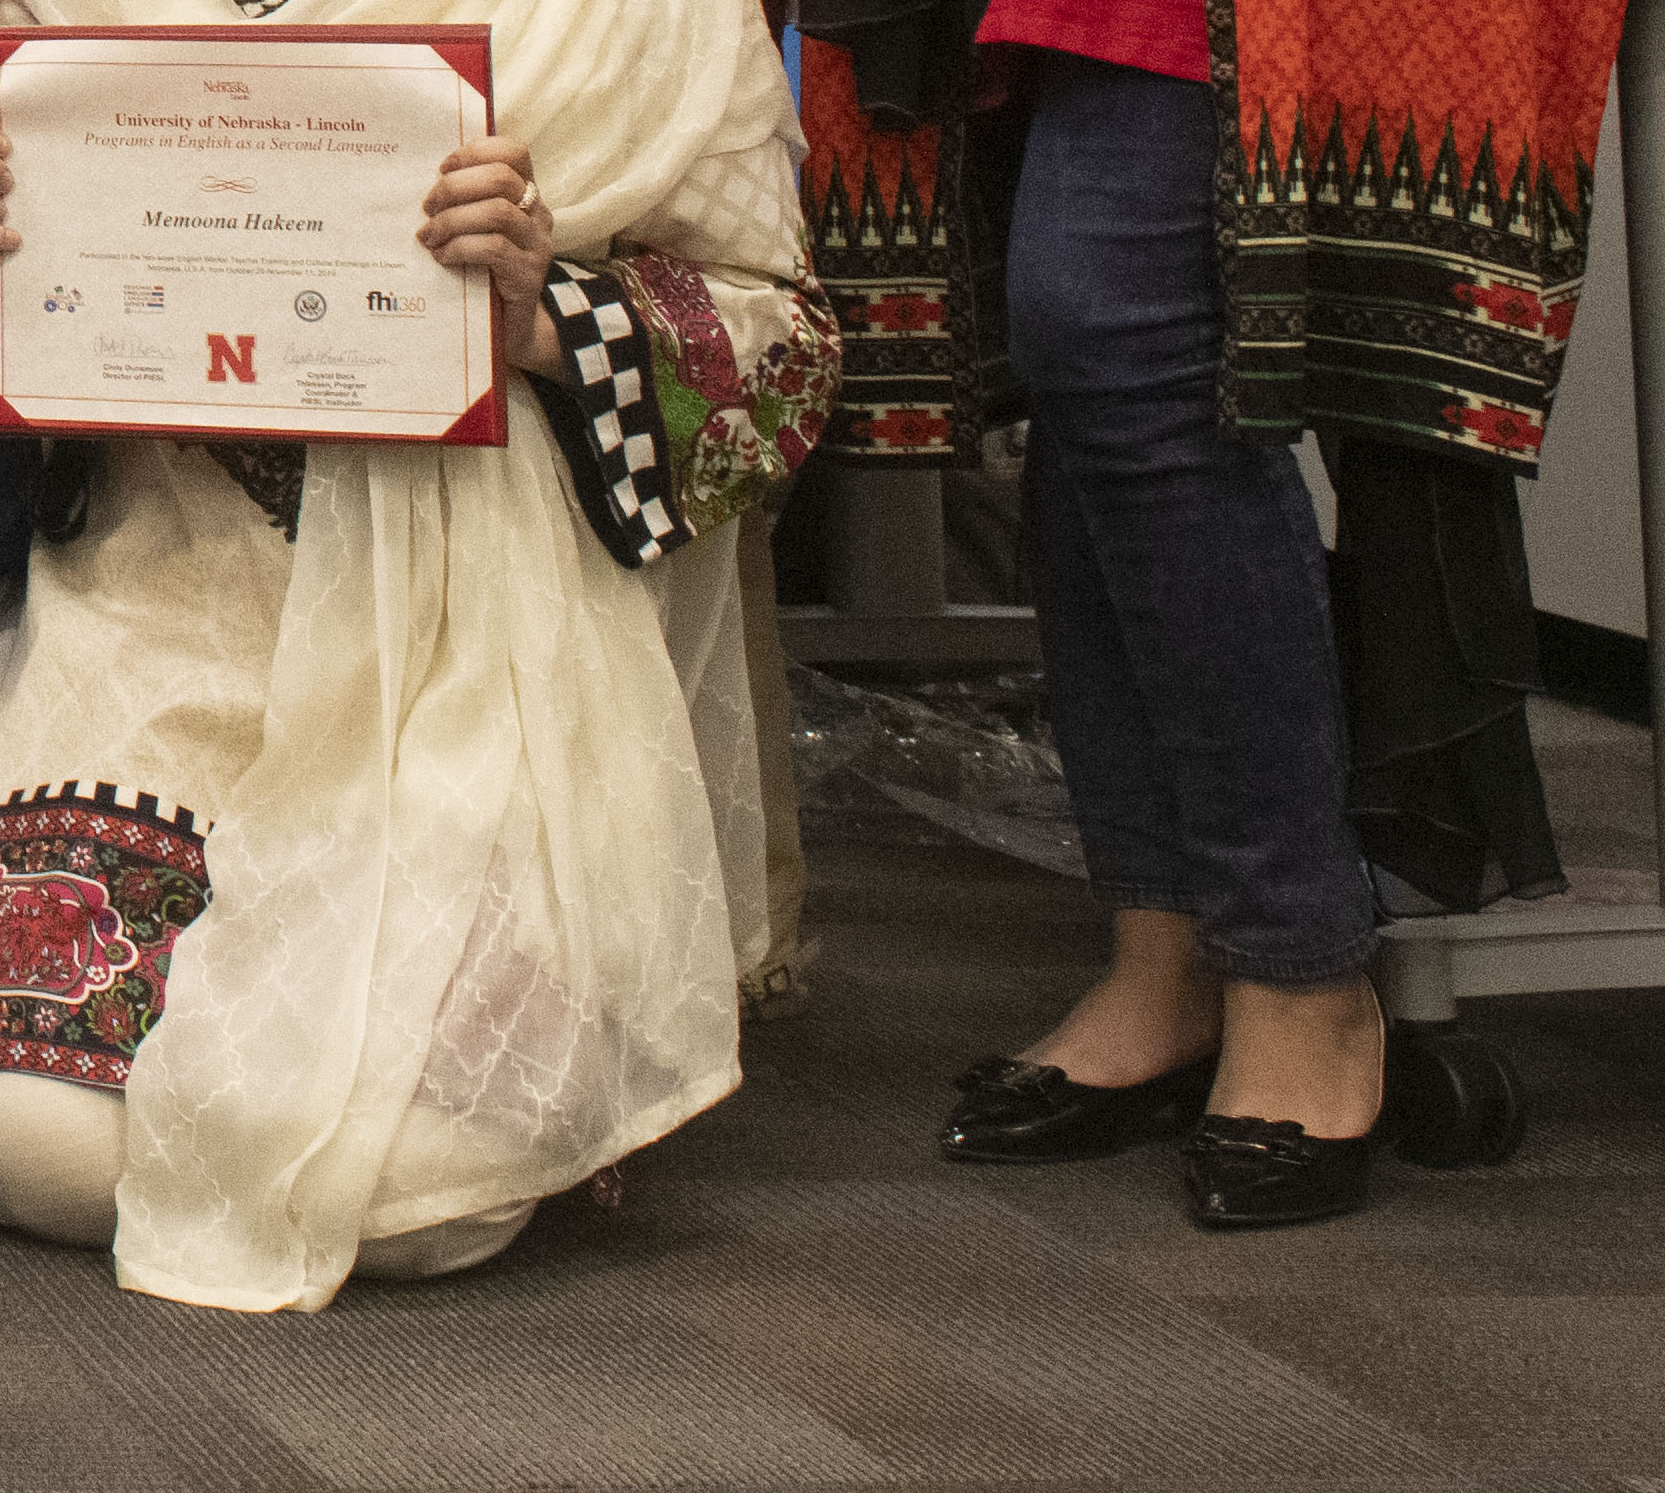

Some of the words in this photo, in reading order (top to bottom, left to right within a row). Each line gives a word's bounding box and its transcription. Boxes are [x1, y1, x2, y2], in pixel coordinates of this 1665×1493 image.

[115, 114, 192, 130] University
[199, 113, 215, 128] of
[218, 115, 291, 131] Nebraska
[307, 118, 366, 132] Lincoln
[84, 132, 154, 151] Programs
[159, 135, 173, 148] in
[177, 135, 231, 151] English
[235, 138, 252, 150] as
[255, 140, 265, 150] a
[270, 136, 322, 152] Second
[326, 138, 399, 155] Language
[142, 211, 239, 230] Memoona
[244, 214, 325, 233] Hakeem
[206, 333, 258, 383] N
